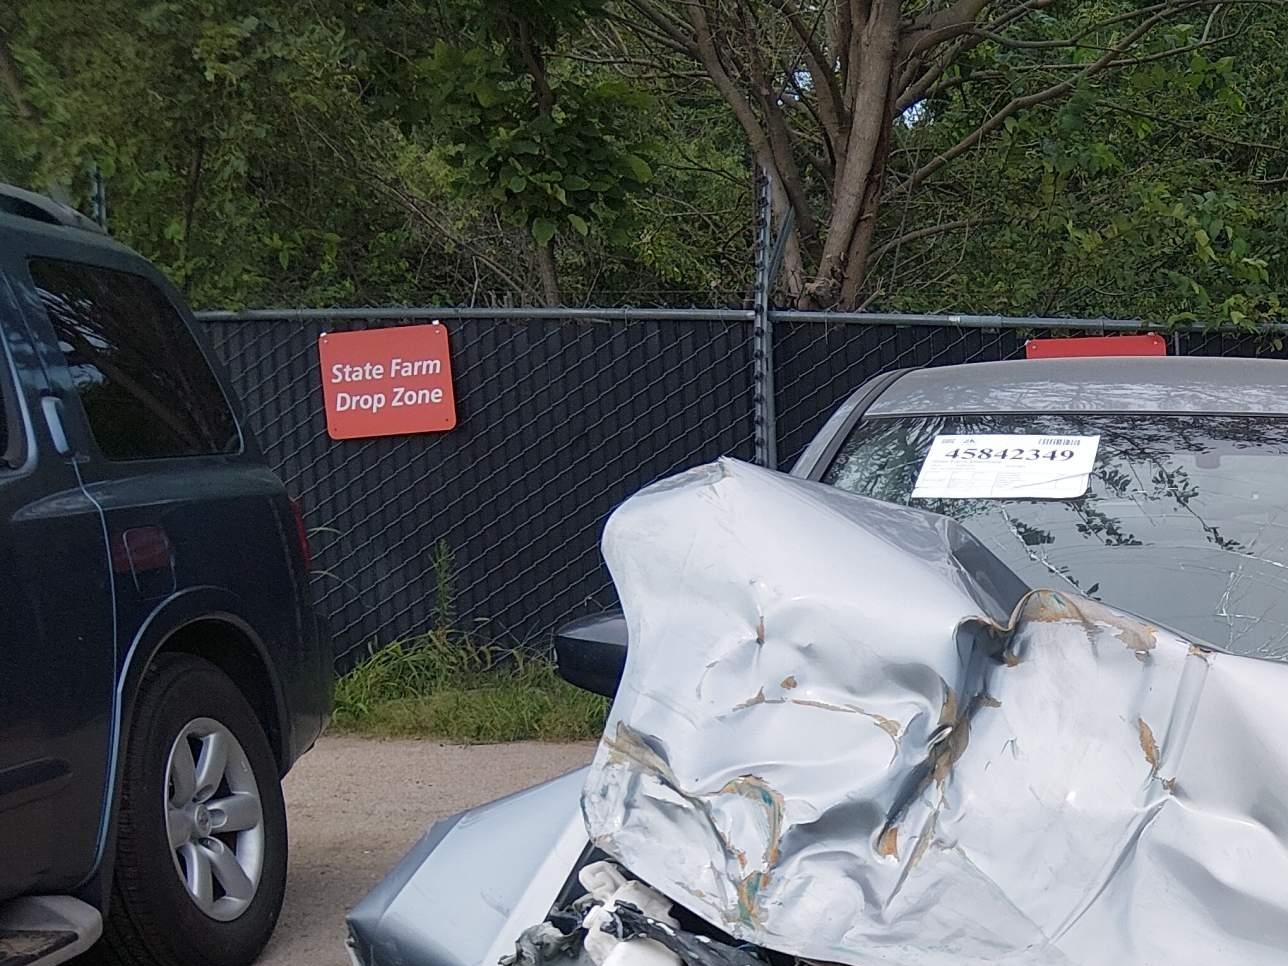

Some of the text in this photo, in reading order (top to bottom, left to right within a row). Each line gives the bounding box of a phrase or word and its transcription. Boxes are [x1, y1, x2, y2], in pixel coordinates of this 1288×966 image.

[331, 358, 441, 384] State Farm
[336, 387, 443, 413] Drop Zone
[945, 448, 1075, 461] 45842349
